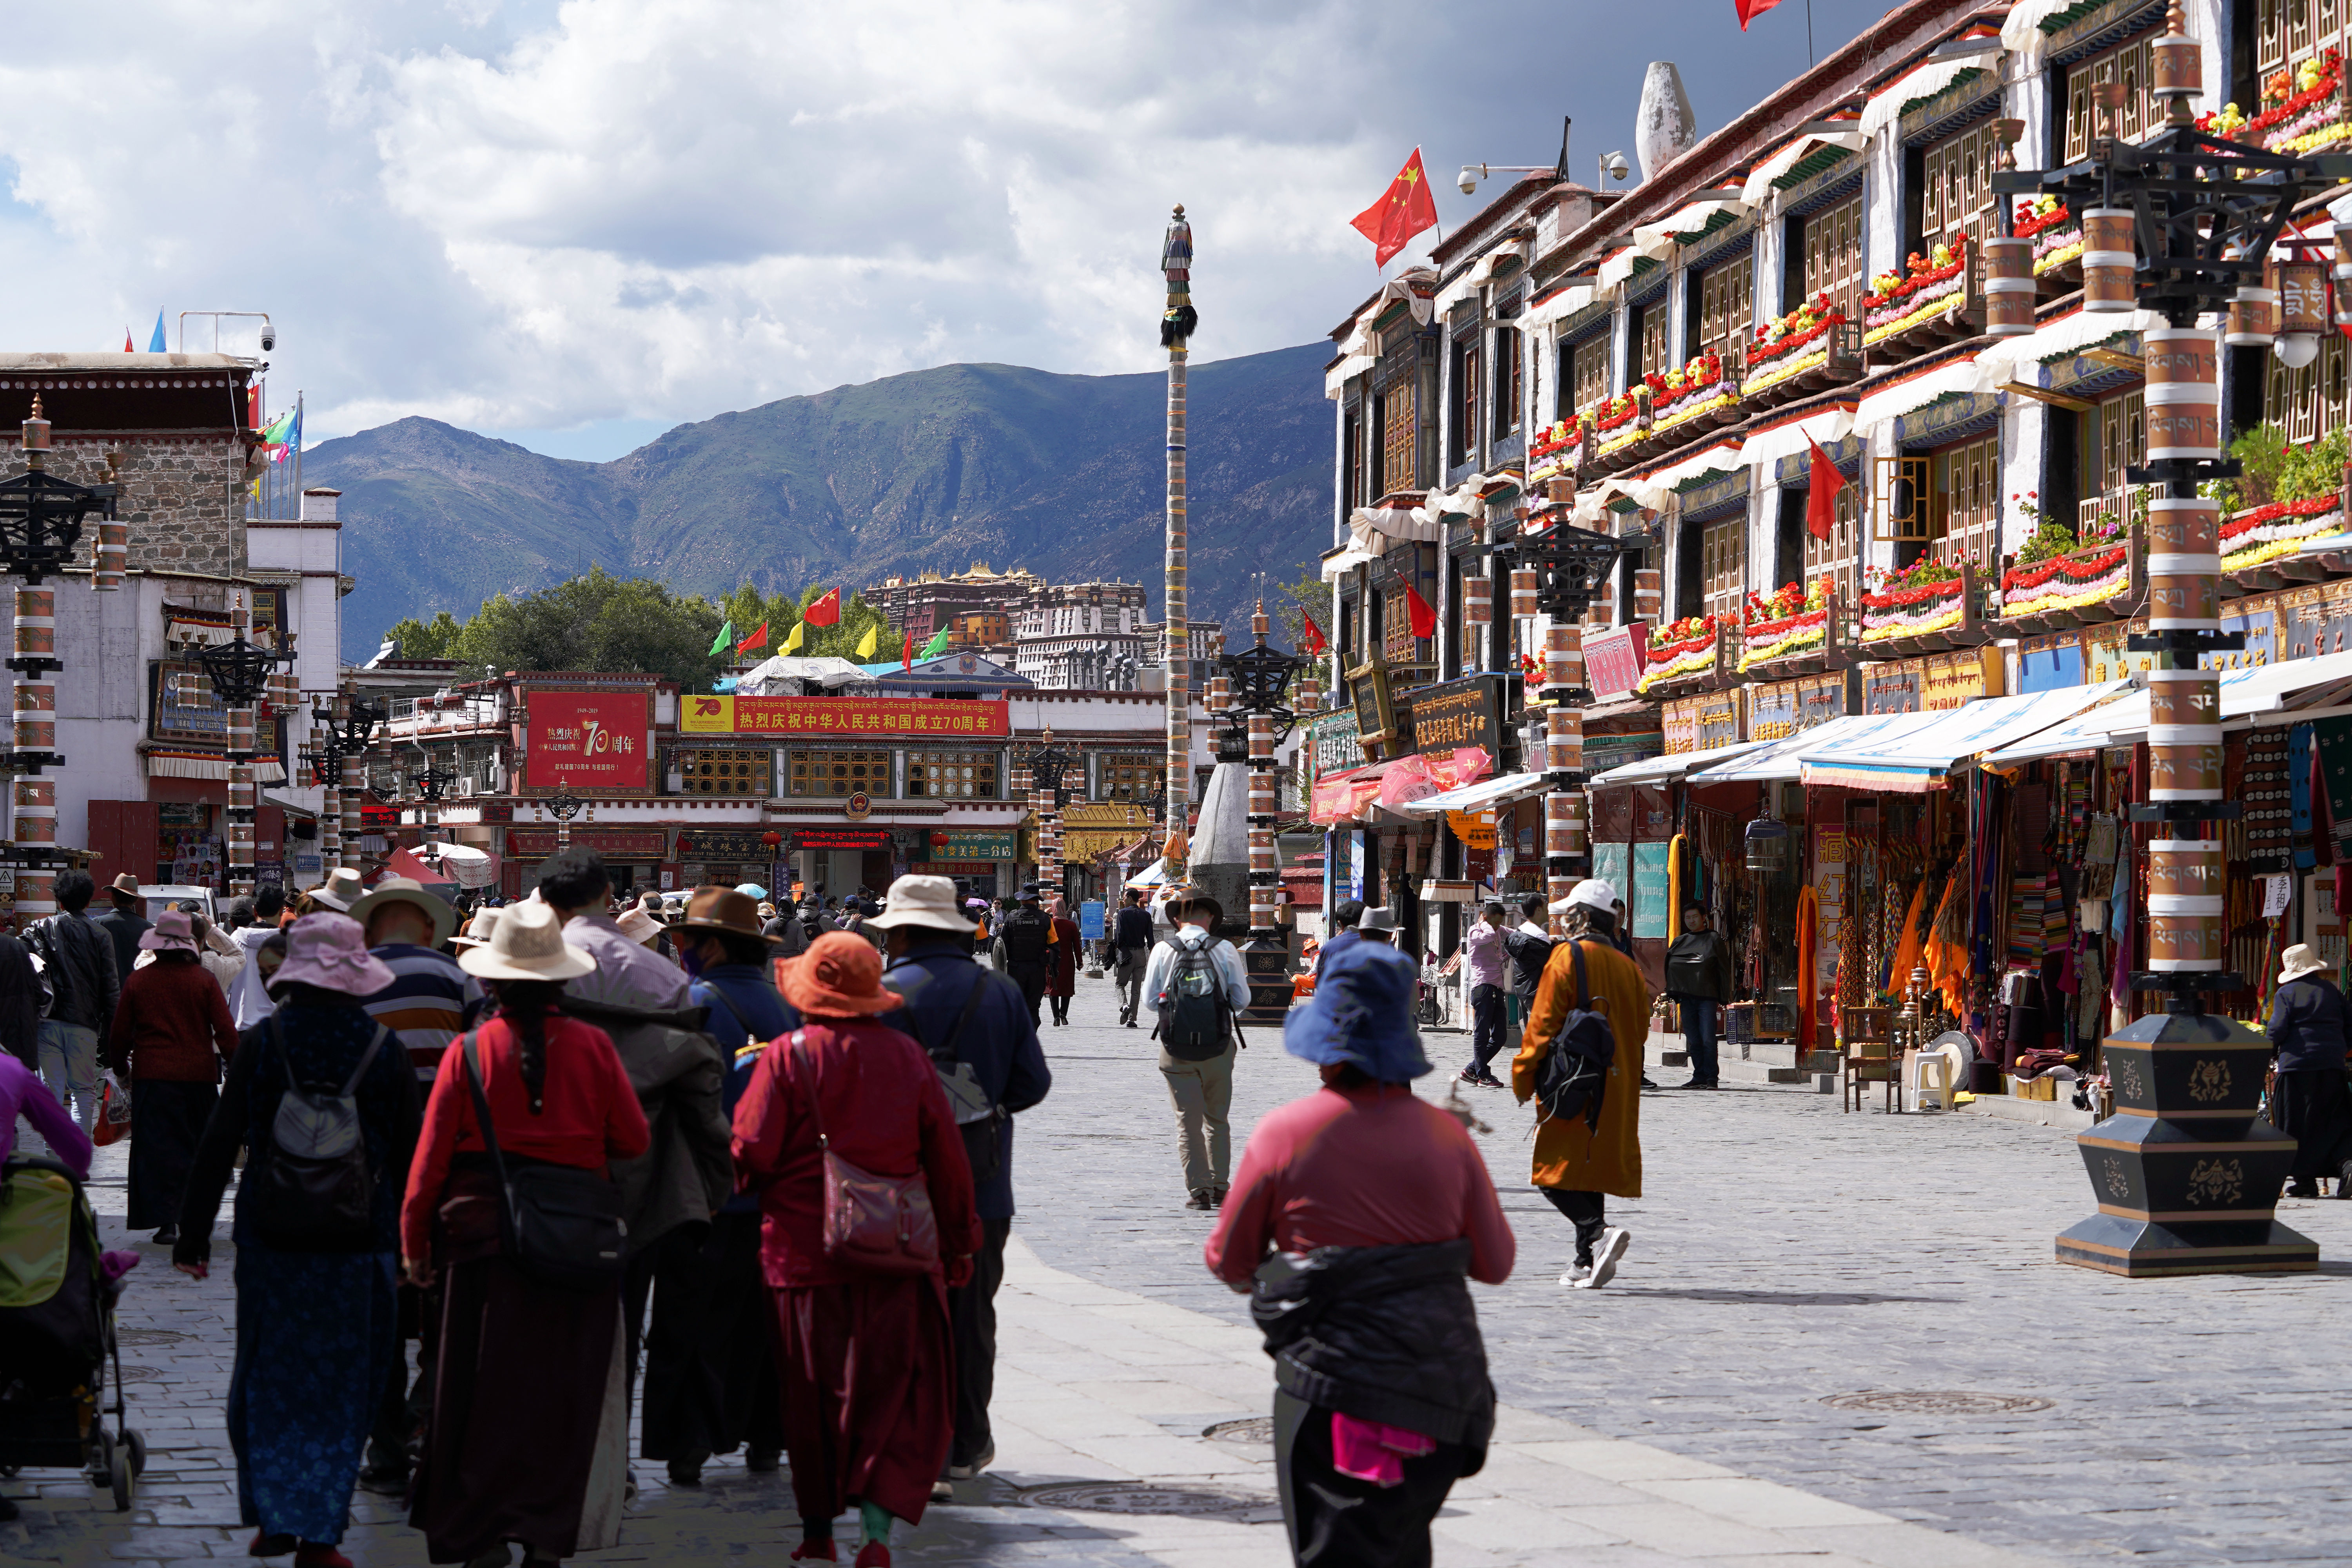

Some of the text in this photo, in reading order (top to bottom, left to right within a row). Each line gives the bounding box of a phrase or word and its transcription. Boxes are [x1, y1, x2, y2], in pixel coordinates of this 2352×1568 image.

[739, 713, 996, 731] 热烈庆祝中华人民共和国成立70周年！
[548, 728, 581, 740] 热烈庆祝
[611, 736, 635, 754] 周年
[917, 864, 988, 873] 全场特价100元
[1636, 861, 1664, 875] shang
[1636, 883, 1664, 898] shung
[1635, 912, 1664, 925] Antique
